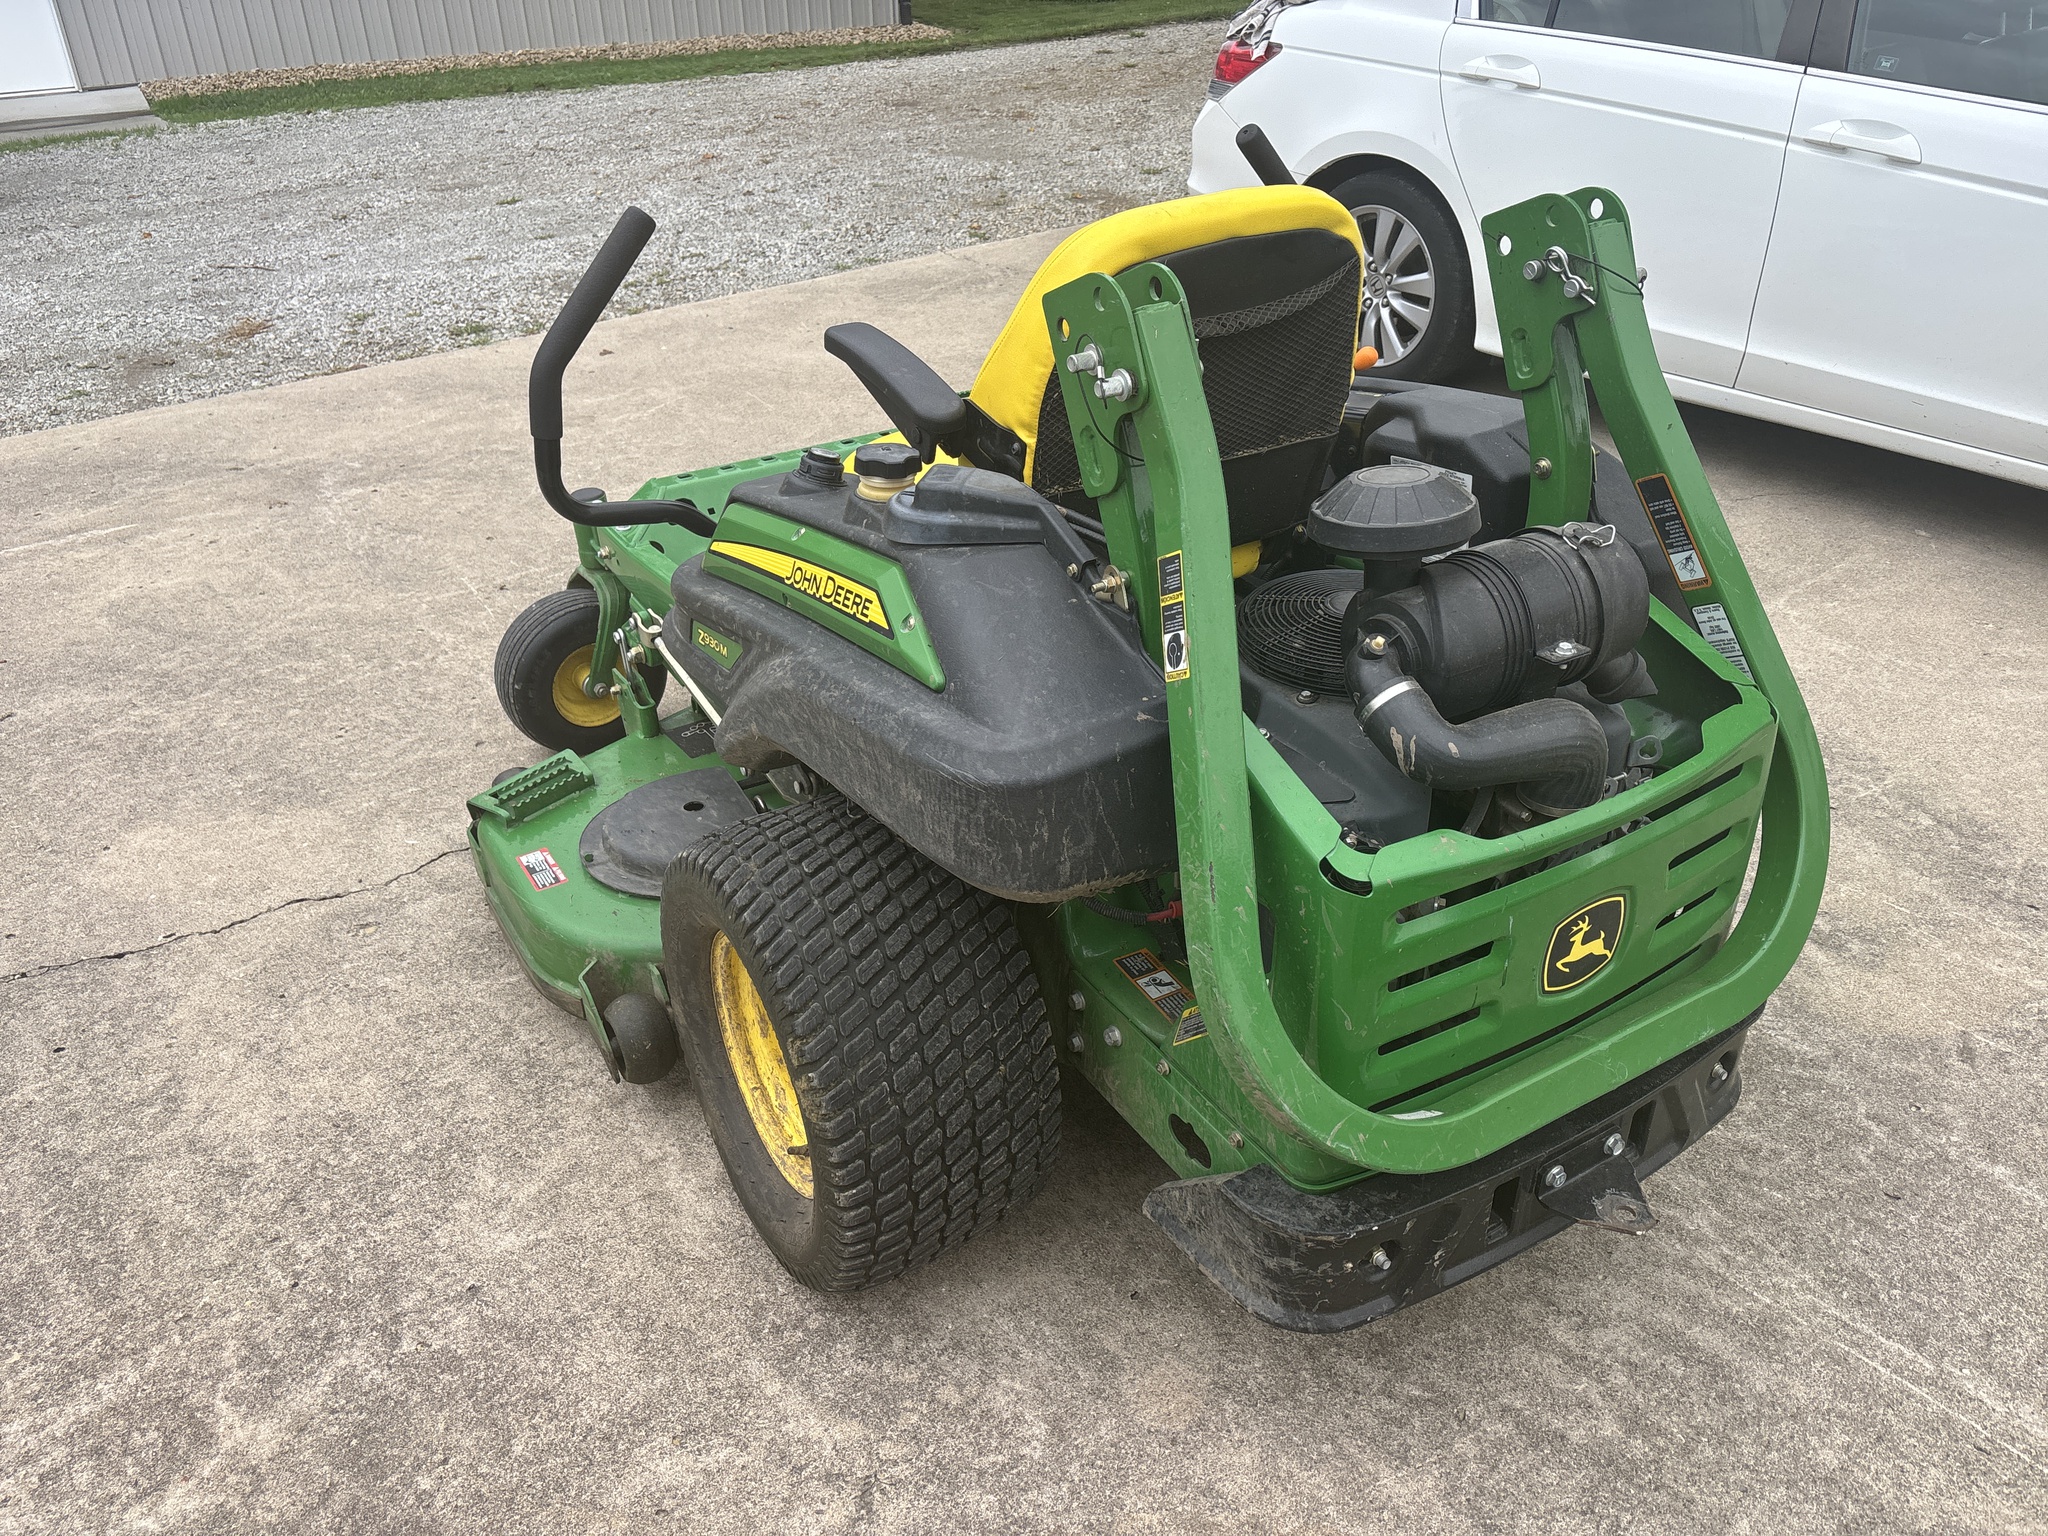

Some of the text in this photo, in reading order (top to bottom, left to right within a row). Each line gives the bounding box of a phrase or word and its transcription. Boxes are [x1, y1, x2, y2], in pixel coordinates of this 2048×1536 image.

[785, 560, 874, 619] JOHN DEERE
[697, 628, 728, 659] Z930M
